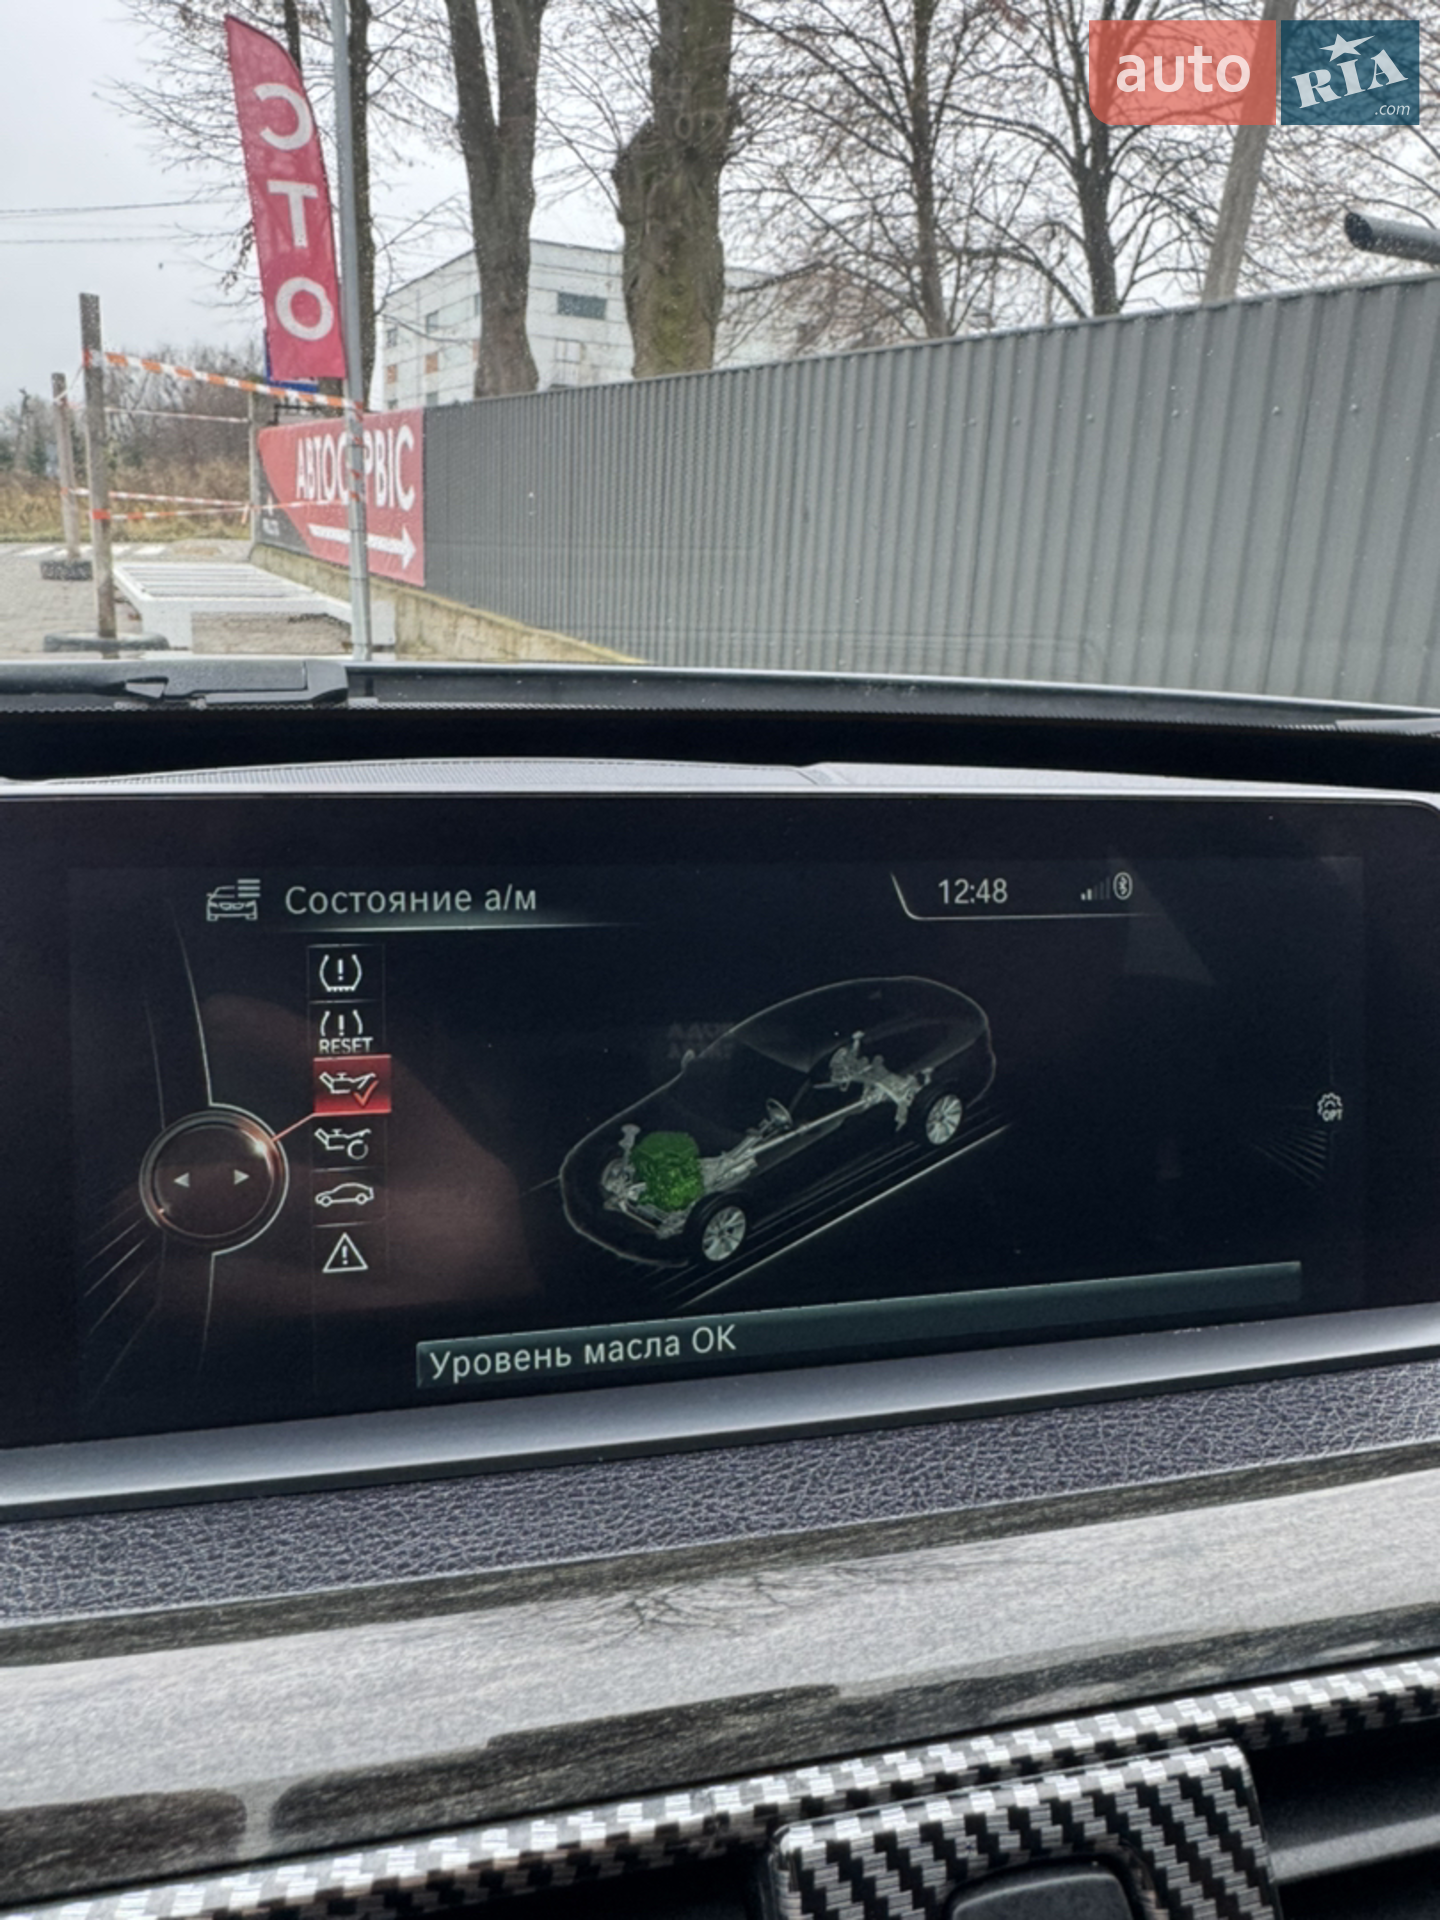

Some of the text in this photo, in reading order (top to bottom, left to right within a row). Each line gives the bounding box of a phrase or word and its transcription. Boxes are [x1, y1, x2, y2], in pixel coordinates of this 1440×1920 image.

[296, 424, 416, 512] АВТОСРВІС
[285, 884, 537, 915] Состояние а/м
[938, 878, 1008, 905] 12:48
[318, 1036, 374, 1055] RESET
[430, 1323, 737, 1384] Уровень масла ОК
